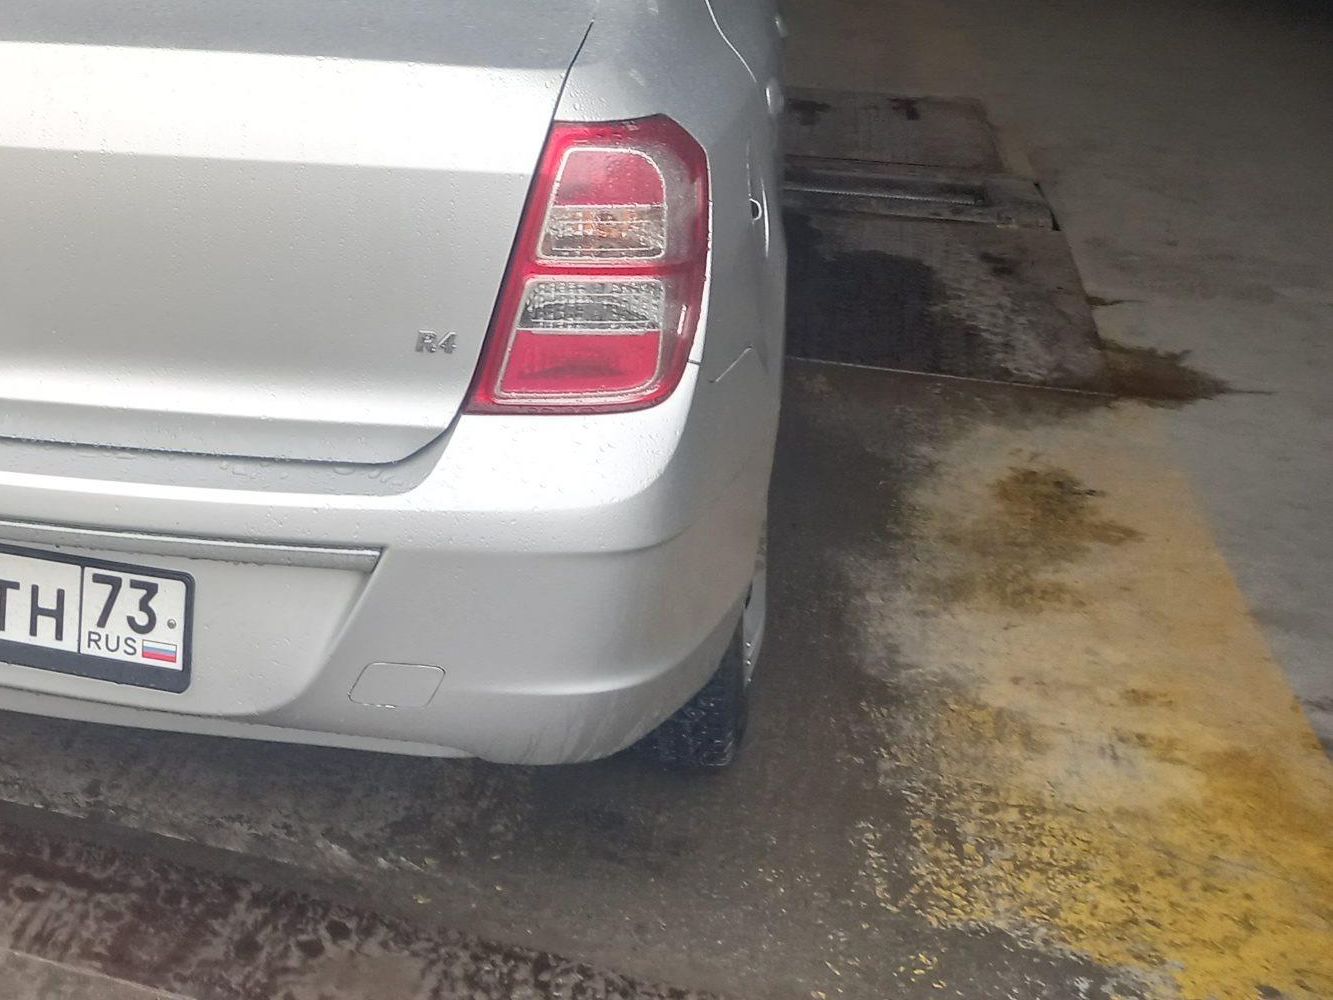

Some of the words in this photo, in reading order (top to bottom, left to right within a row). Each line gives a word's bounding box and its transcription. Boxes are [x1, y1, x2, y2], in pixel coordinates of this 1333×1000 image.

[415, 329, 457, 354] R4
[92, 573, 158, 634] 73
[87, 631, 137, 656] RUS
